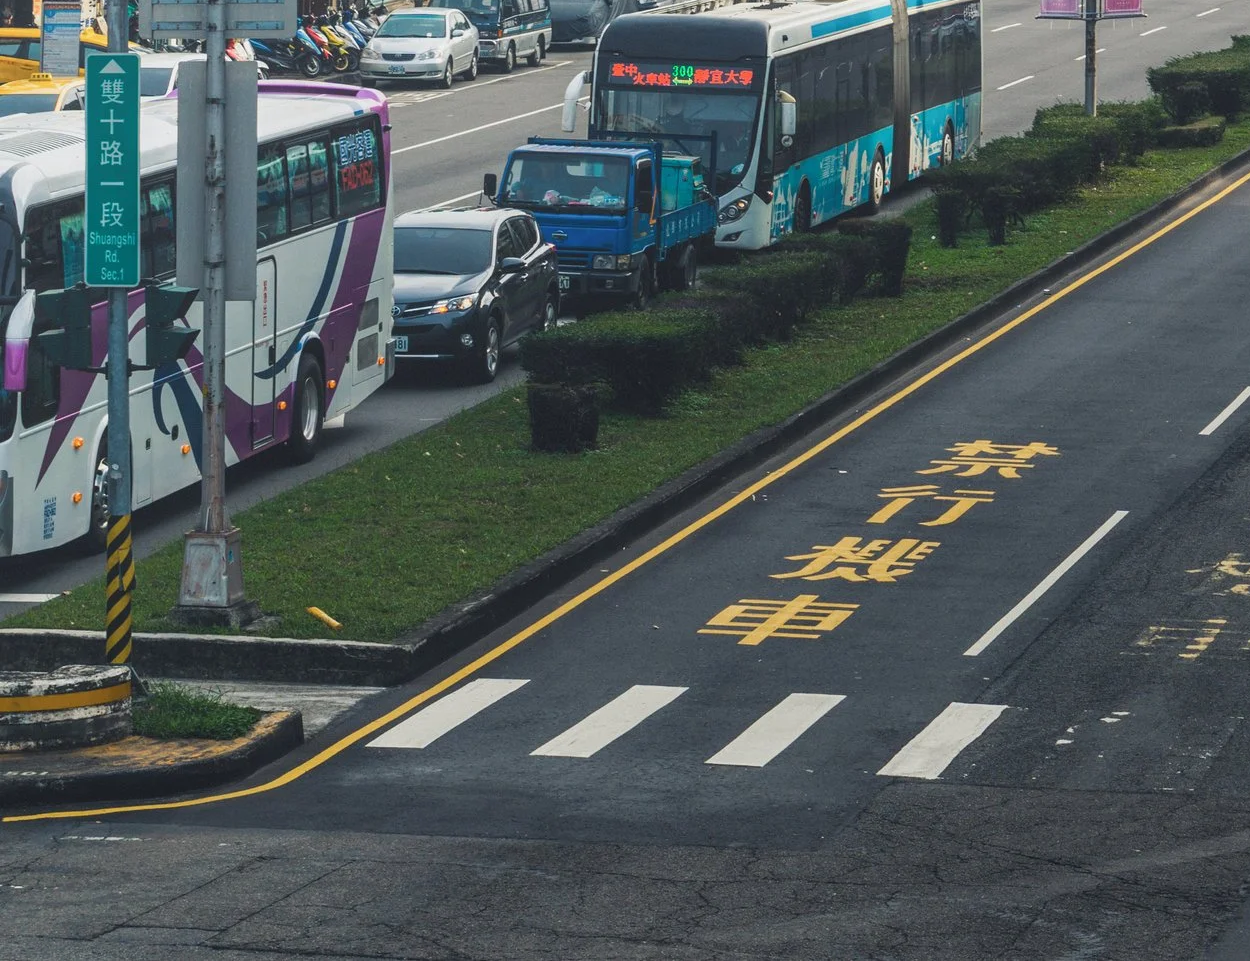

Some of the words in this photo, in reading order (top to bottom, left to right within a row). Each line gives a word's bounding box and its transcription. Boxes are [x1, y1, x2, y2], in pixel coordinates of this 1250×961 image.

[672, 65, 694, 77] 300
[694, 69, 753, 86] 靜宜大學
[100, 79, 124, 227] 雙十路一段
[89, 232, 136, 245] Shuangshi
[105, 250, 120, 263] Rd.
[100, 267, 124, 281] Sec.1
[697, 439, 1062, 645] 禁行機車
